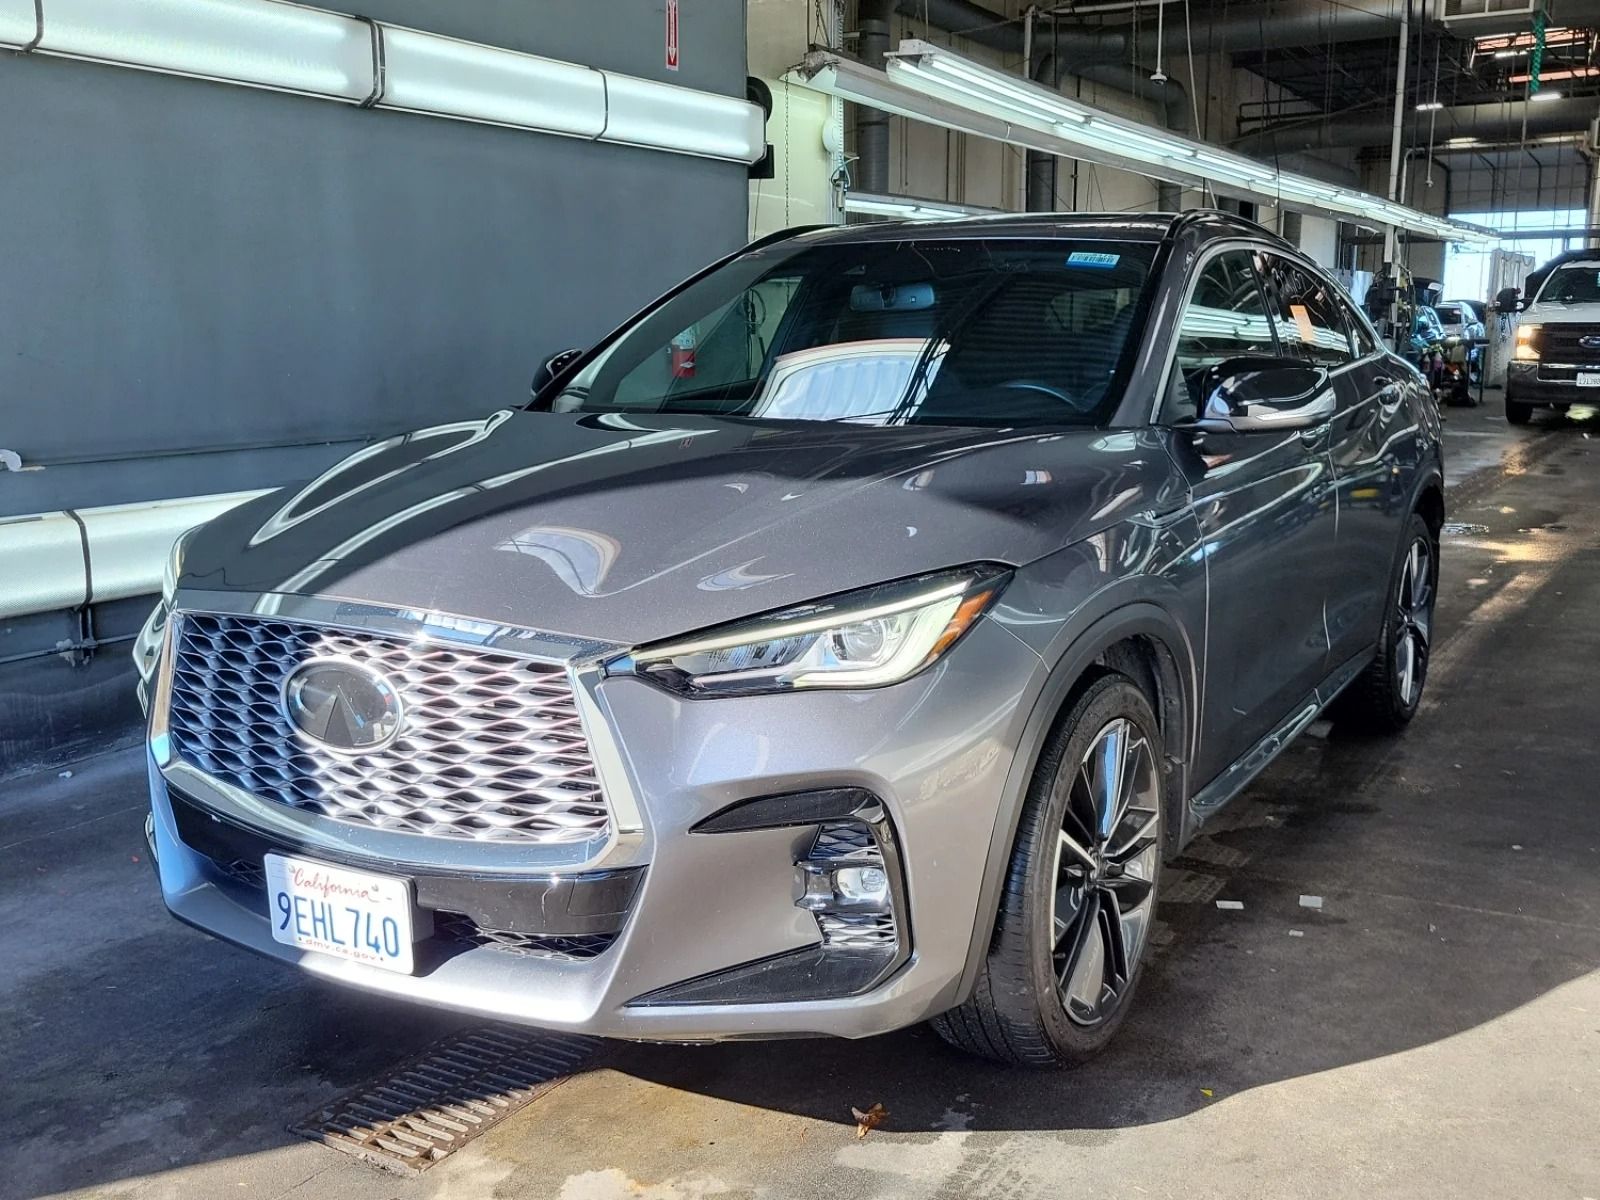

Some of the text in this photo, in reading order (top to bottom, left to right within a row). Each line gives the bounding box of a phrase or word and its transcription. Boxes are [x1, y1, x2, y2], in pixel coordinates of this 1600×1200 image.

[294, 868, 378, 903] California
[277, 891, 400, 958] 9EHL740
[305, 938, 378, 961] dmv.ca.gov
